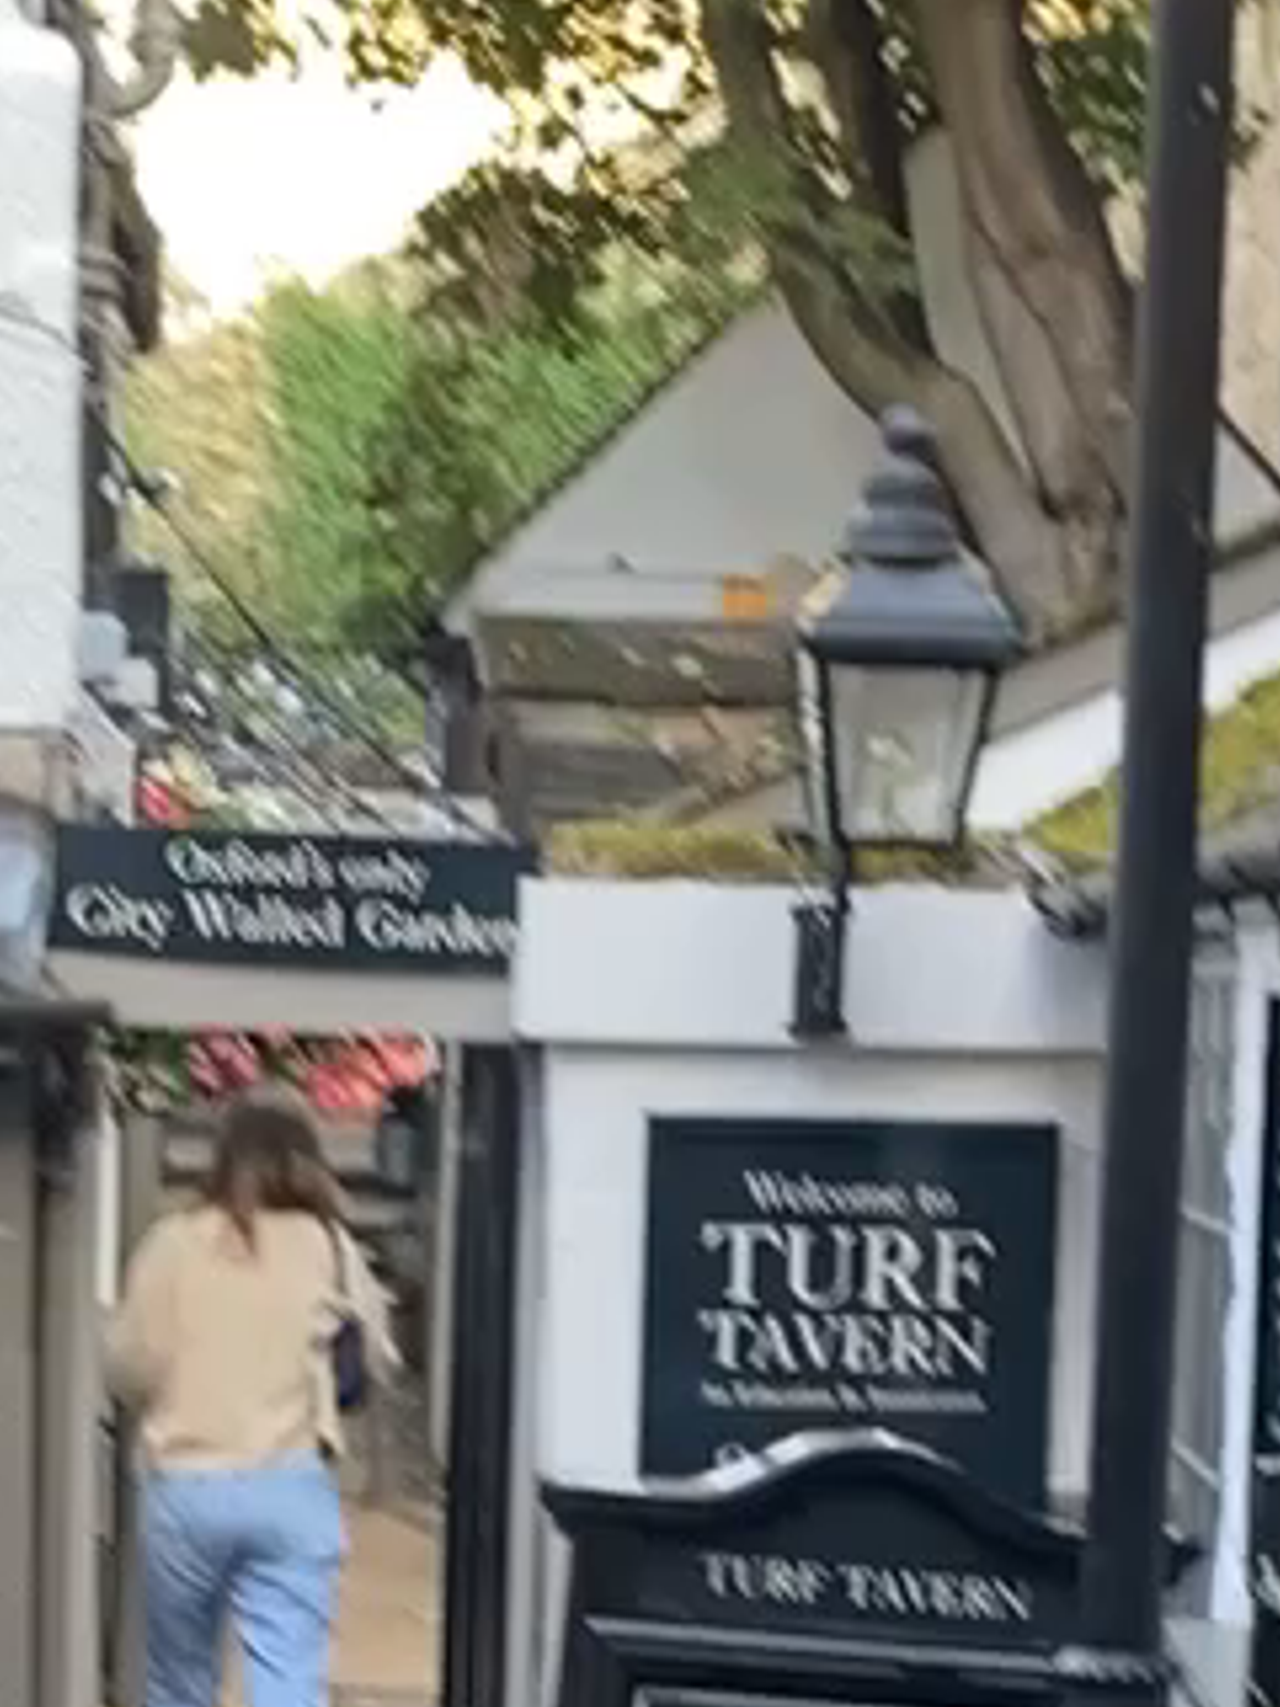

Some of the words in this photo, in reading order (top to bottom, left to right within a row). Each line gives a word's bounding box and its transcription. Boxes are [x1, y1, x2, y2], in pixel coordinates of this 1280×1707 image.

[65, 883, 175, 951] City
[183, 889, 348, 949] Walled
[743, 1169, 908, 1218] Welcome
[914, 1182, 959, 1219] to
[700, 1219, 997, 1313] TURF
[697, 1307, 993, 1376] TAVERN
[702, 1552, 832, 1605] TURF
[838, 1562, 1034, 1621] TAVERN
